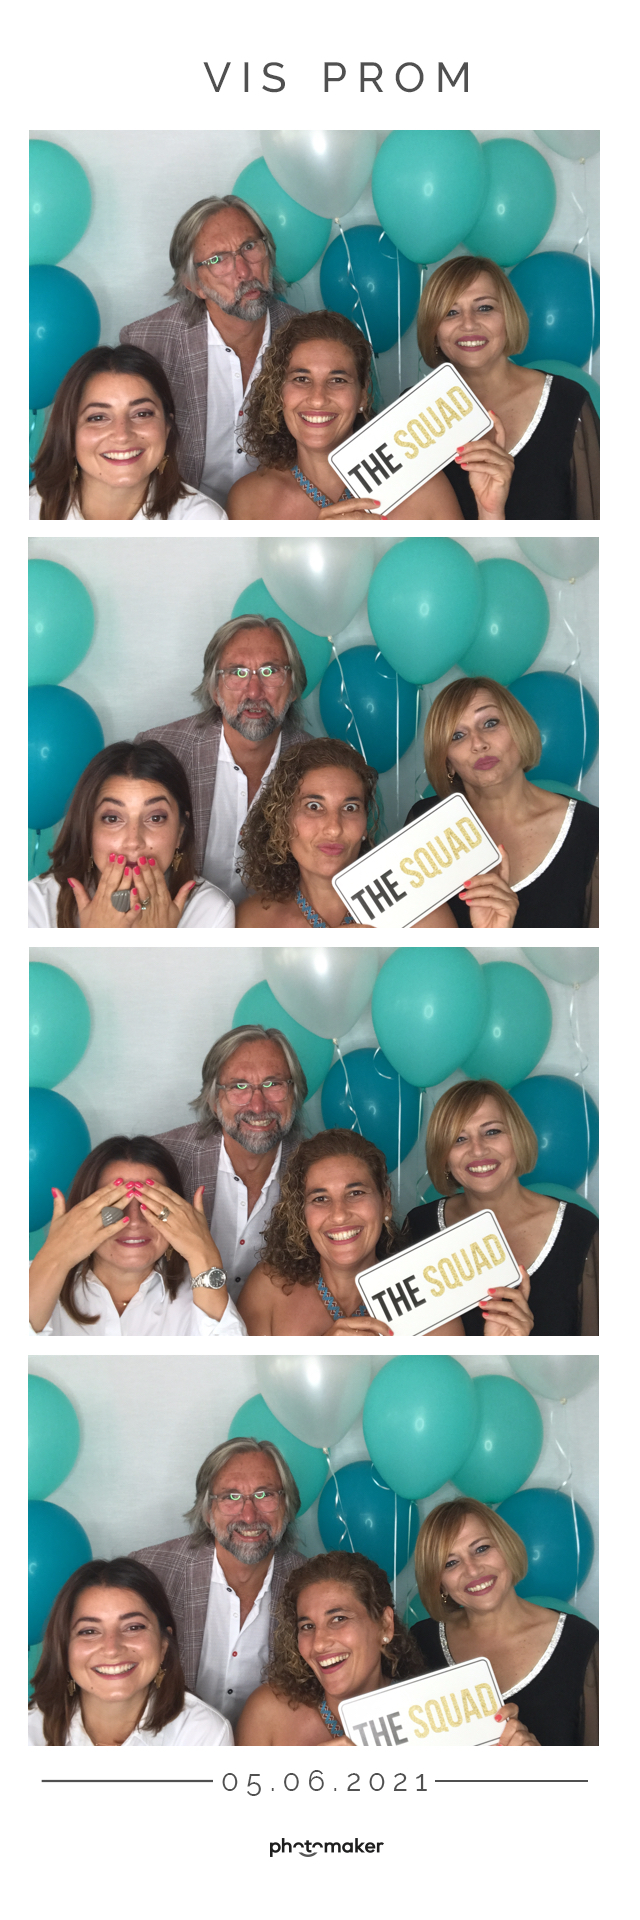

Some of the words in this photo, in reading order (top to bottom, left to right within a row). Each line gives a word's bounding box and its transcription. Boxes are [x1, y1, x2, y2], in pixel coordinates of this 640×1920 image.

[347, 442, 403, 494] THE
[393, 385, 474, 460] SQUAD
[350, 868, 408, 921] THE
[399, 816, 483, 889] SQUAD
[371, 1274, 427, 1323] THE
[422, 1233, 506, 1298] SQUAD
[352, 1711, 409, 1746] THE
[408, 1682, 498, 1739] SQUAD
